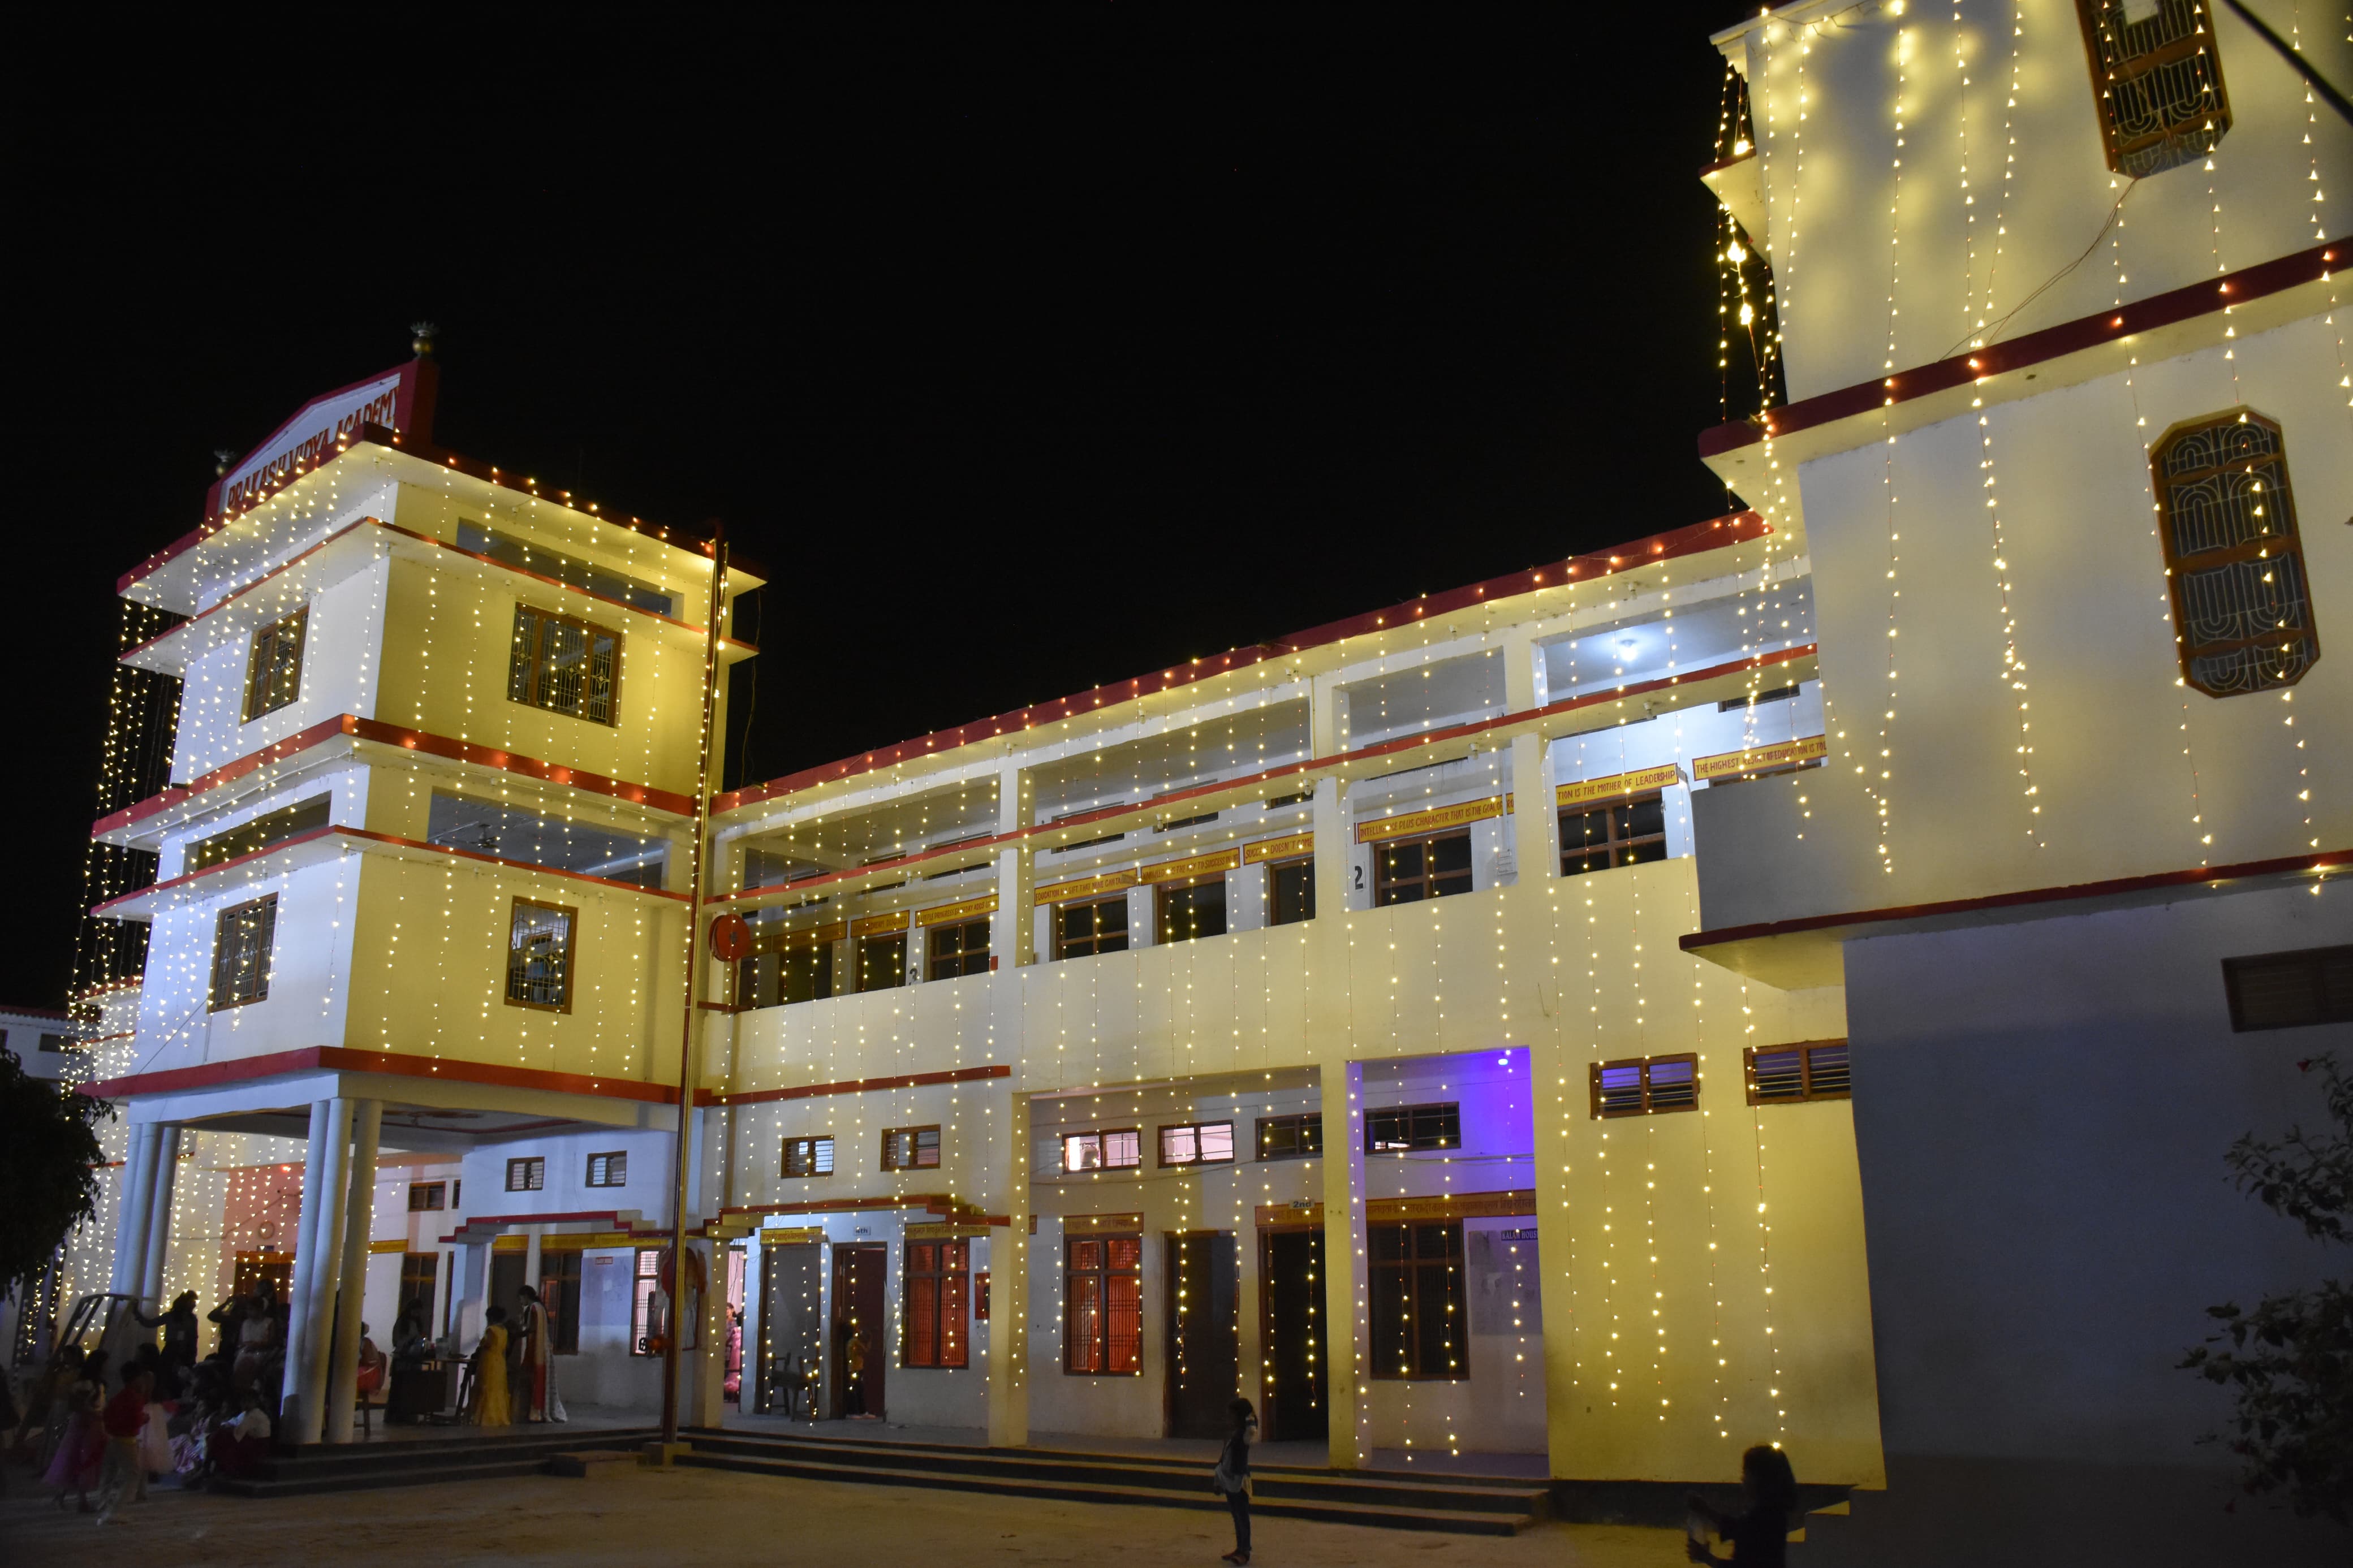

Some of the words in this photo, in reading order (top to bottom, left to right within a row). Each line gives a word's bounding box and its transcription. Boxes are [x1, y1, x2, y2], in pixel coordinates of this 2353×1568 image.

[289, 428, 330, 469] VIDYA
[1696, 763, 1708, 774] THE
[1710, 758, 1739, 771] HIGHEST
[1809, 744, 1815, 753] IS
[1575, 788, 1580, 797] IS
[1583, 785, 1595, 796] THE
[1597, 780, 1621, 793] MOTHER
[1624, 778, 1632, 788] OF
[1636, 770, 1675, 787] LEADERSHIP
[1360, 823, 1397, 838] INTELLIGECE
[1399, 818, 1414, 832] PLUS
[1415, 812, 1449, 828] CHARACTER
[1450, 809, 1464, 820] THAT
[1466, 807, 1471, 817] IS
[1471, 805, 1482, 816] THE
[1483, 802, 1497, 814] GOAL
[1297, 837, 1313, 849] COME
[1205, 856, 1225, 869] SUCCESS
[1355, 865, 1364, 891] 2
[1036, 888, 1059, 901] EDUCATION
[1079, 882, 1091, 892] THAT
[1293, 1200, 1312, 1208] 2nd
[1522, 1230, 1537, 1239] HOUS
